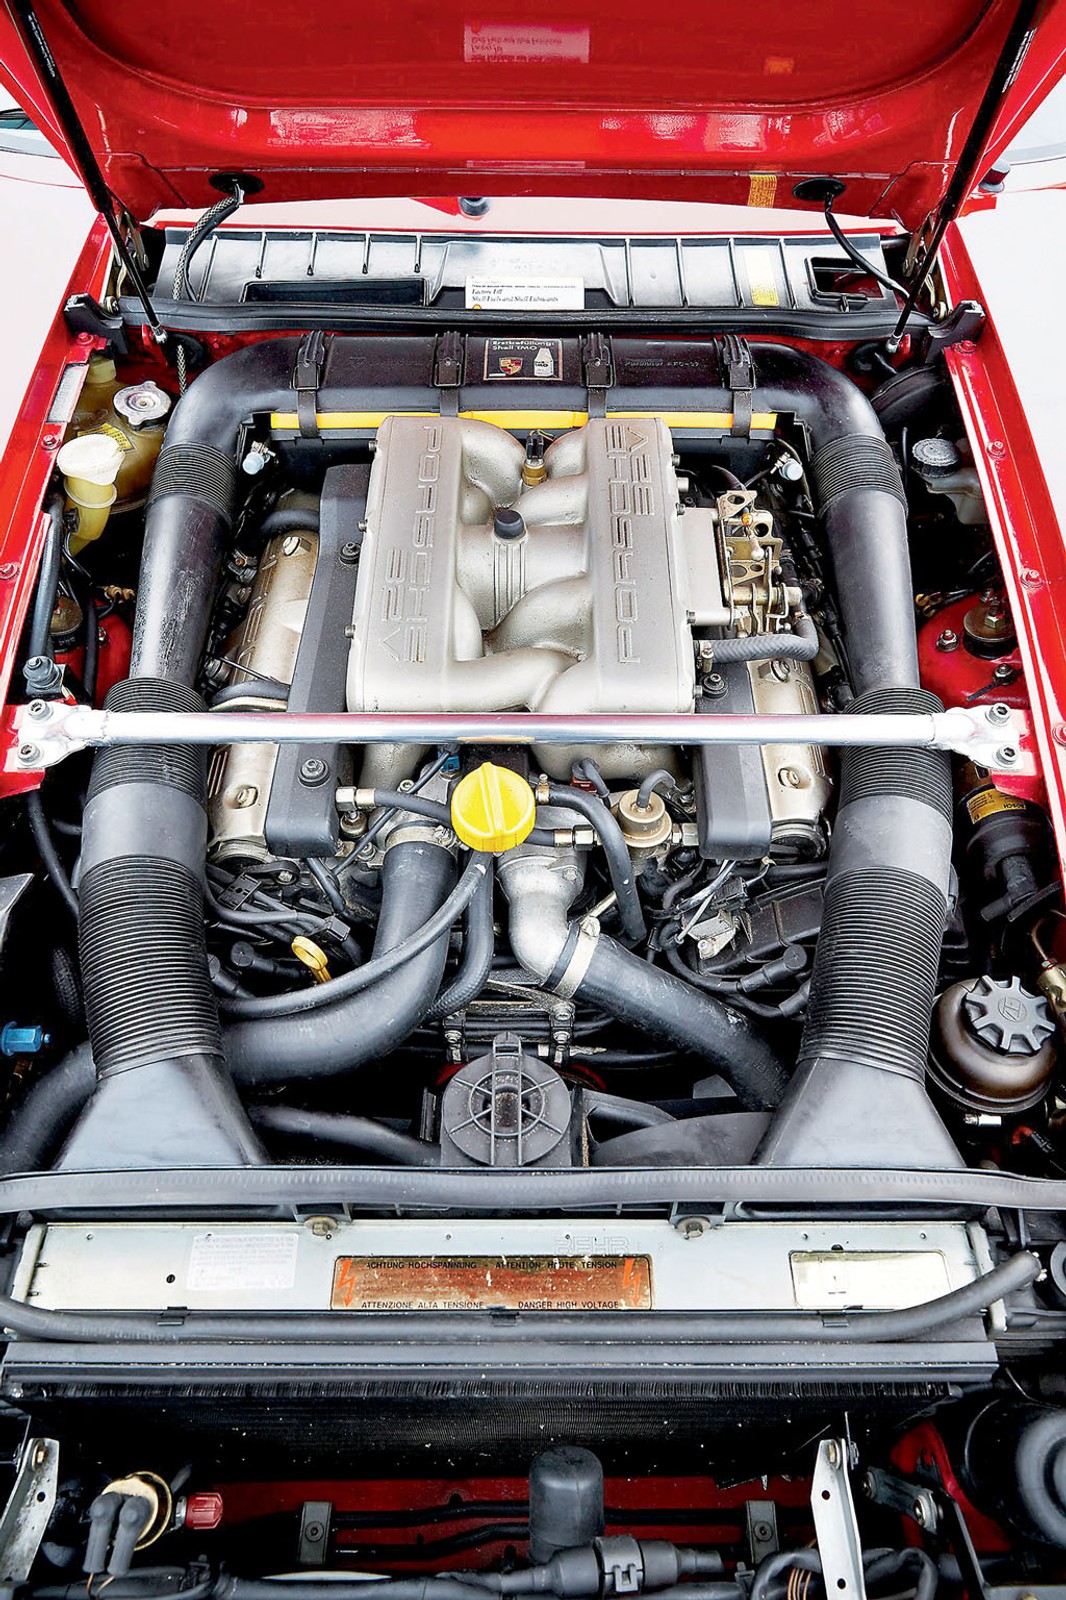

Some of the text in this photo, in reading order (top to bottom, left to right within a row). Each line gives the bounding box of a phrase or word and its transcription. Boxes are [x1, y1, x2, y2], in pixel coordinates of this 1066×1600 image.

[404, 423, 443, 664] PORSCHE
[604, 424, 643, 664] PORSCHE
[366, 1261, 405, 1269] ACHTUNG
[408, 1261, 477, 1269] HOCHSPANNUNG
[495, 1261, 541, 1269] ATTENTION
[581, 1261, 617, 1269] TENSION
[361, 1301, 484, 1309] ATTENZIONE ALTA TENSIONE
[518, 1301, 619, 1309] DANGER HIGH VOLTAGE
